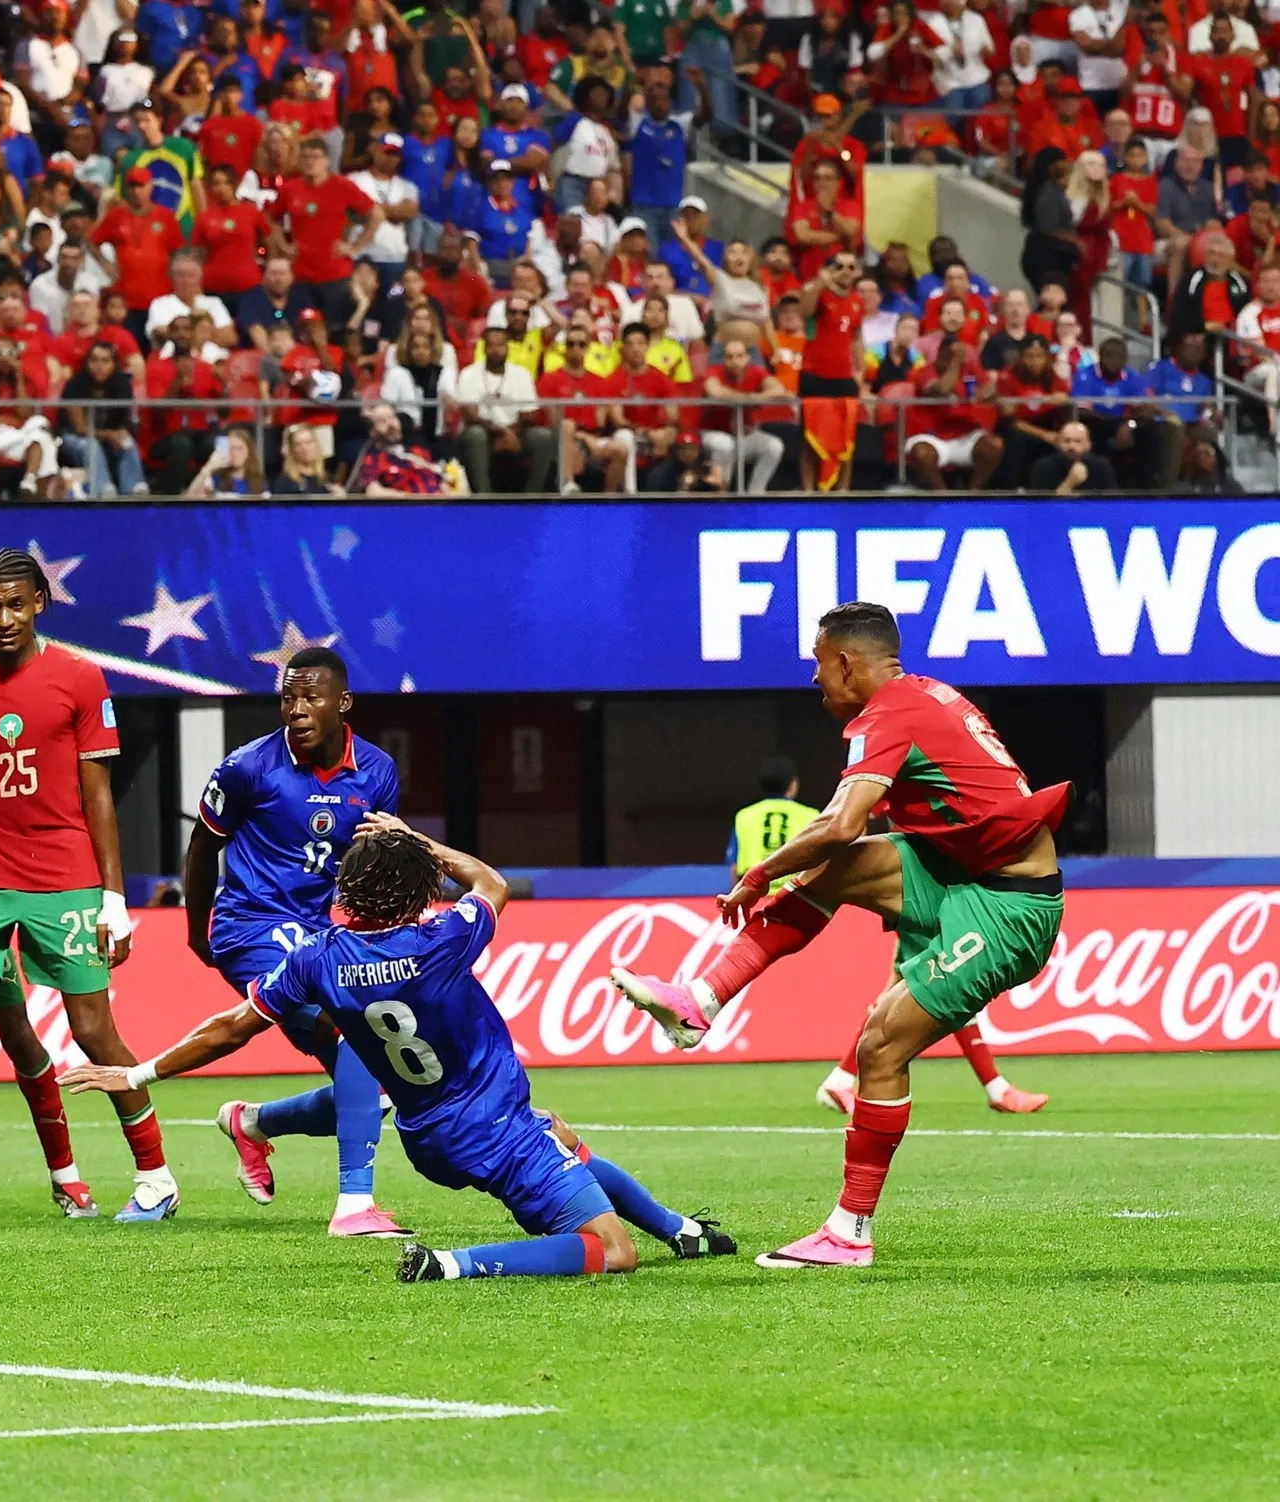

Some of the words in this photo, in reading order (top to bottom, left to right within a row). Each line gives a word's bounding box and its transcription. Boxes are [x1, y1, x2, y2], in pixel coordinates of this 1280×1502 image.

[699, 528, 1048, 661] FIFA
[305, 794, 342, 804] SAETA
[60, 907, 98, 956] 25
[937, 931, 986, 973] 9
[337, 956, 421, 988] EXPERIENCE
[364, 1000, 444, 1085] 8
